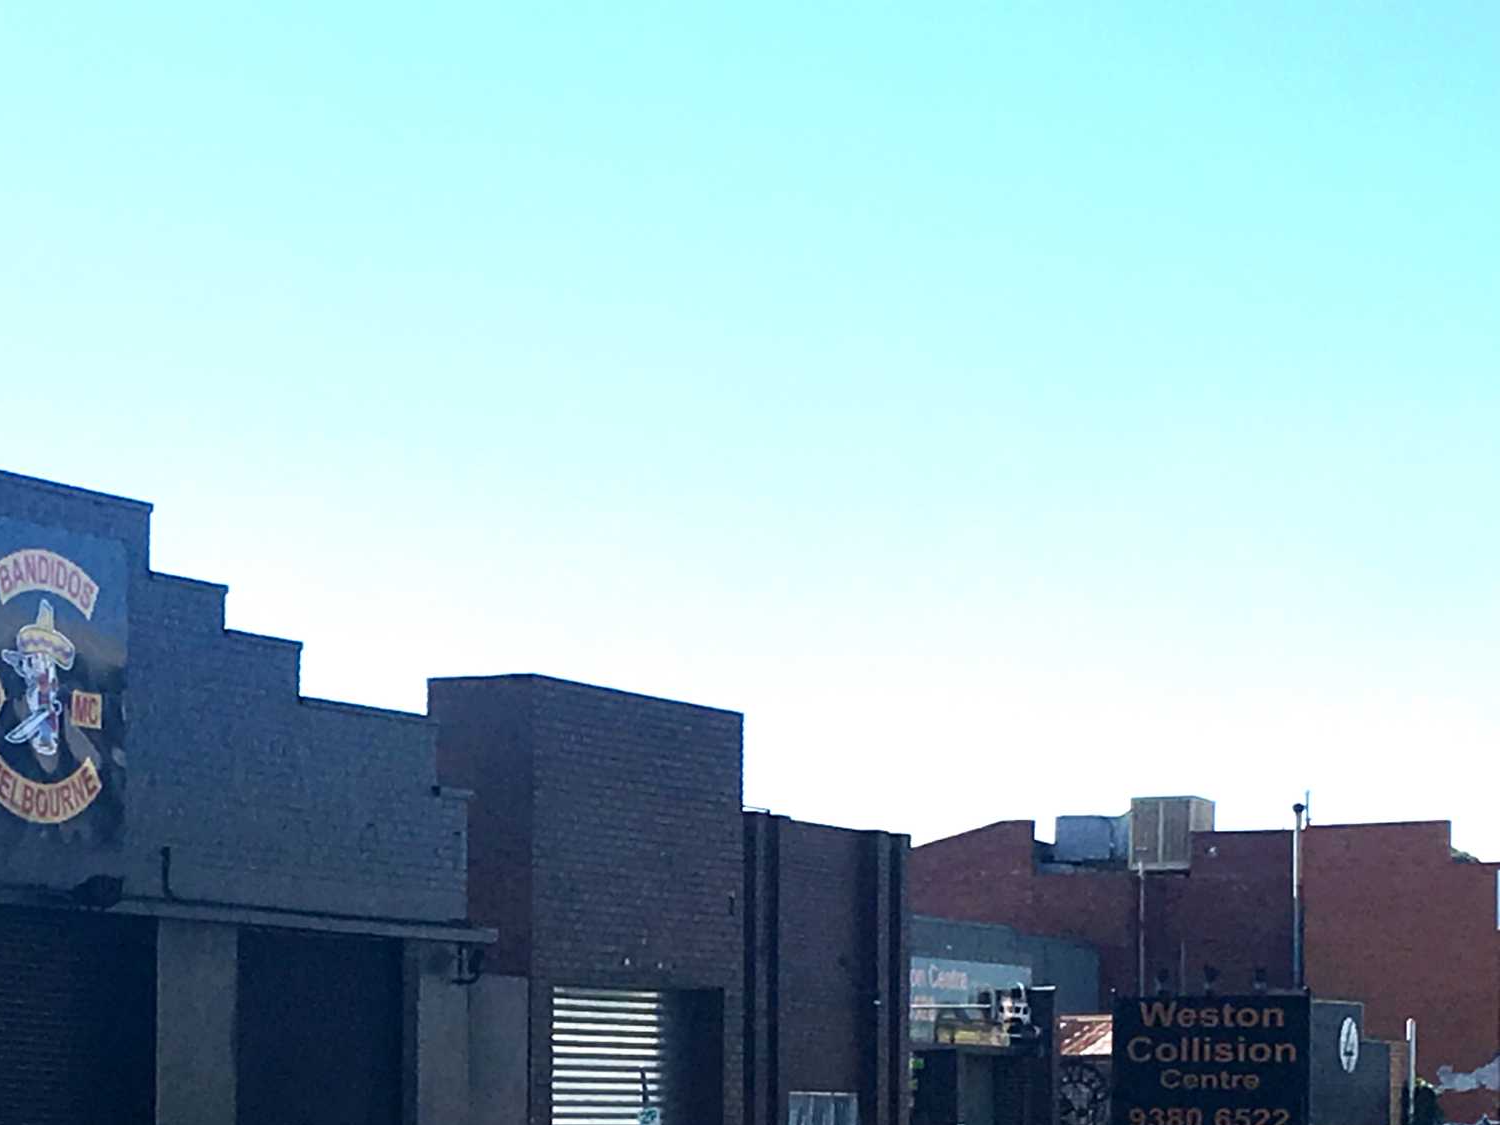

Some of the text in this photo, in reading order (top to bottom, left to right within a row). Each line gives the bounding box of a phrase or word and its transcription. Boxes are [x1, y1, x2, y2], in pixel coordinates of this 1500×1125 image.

[74, 694, 99, 725] MC
[1140, 1001, 1285, 1029] Weston
[1127, 1036, 1298, 1064] Collision
[1160, 1068, 1261, 1089] Centre
